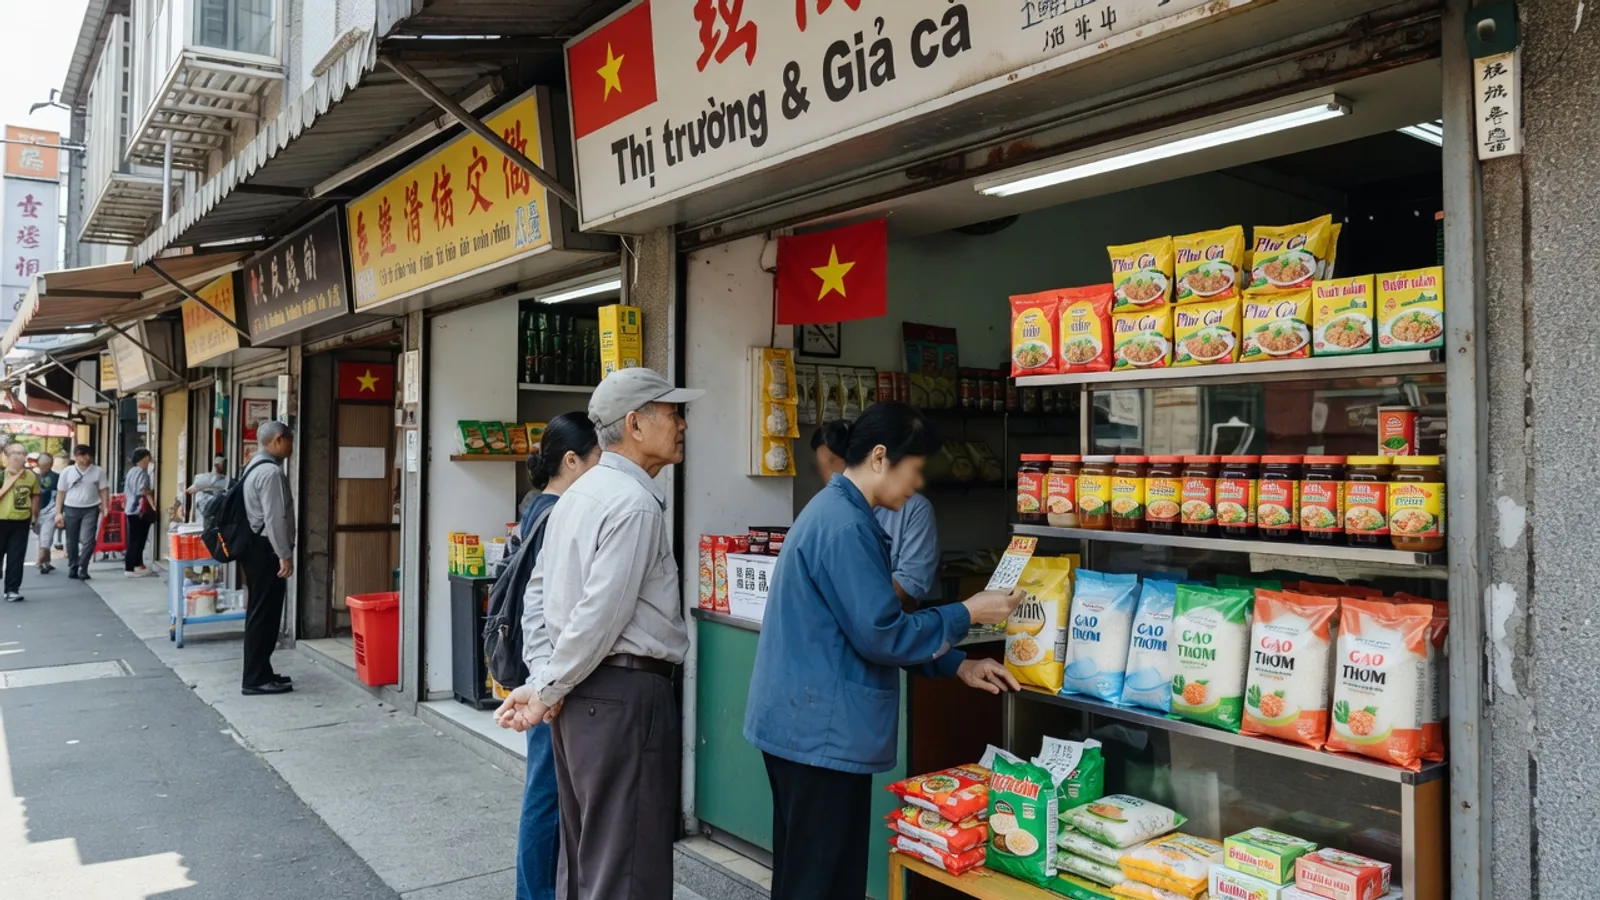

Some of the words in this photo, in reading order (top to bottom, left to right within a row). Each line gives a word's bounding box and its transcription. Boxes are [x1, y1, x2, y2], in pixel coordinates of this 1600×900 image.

[611, 126, 656, 188] Thị
[663, 89, 769, 167] trường
[781, 60, 811, 121] &
[822, 15, 896, 103] Giả
